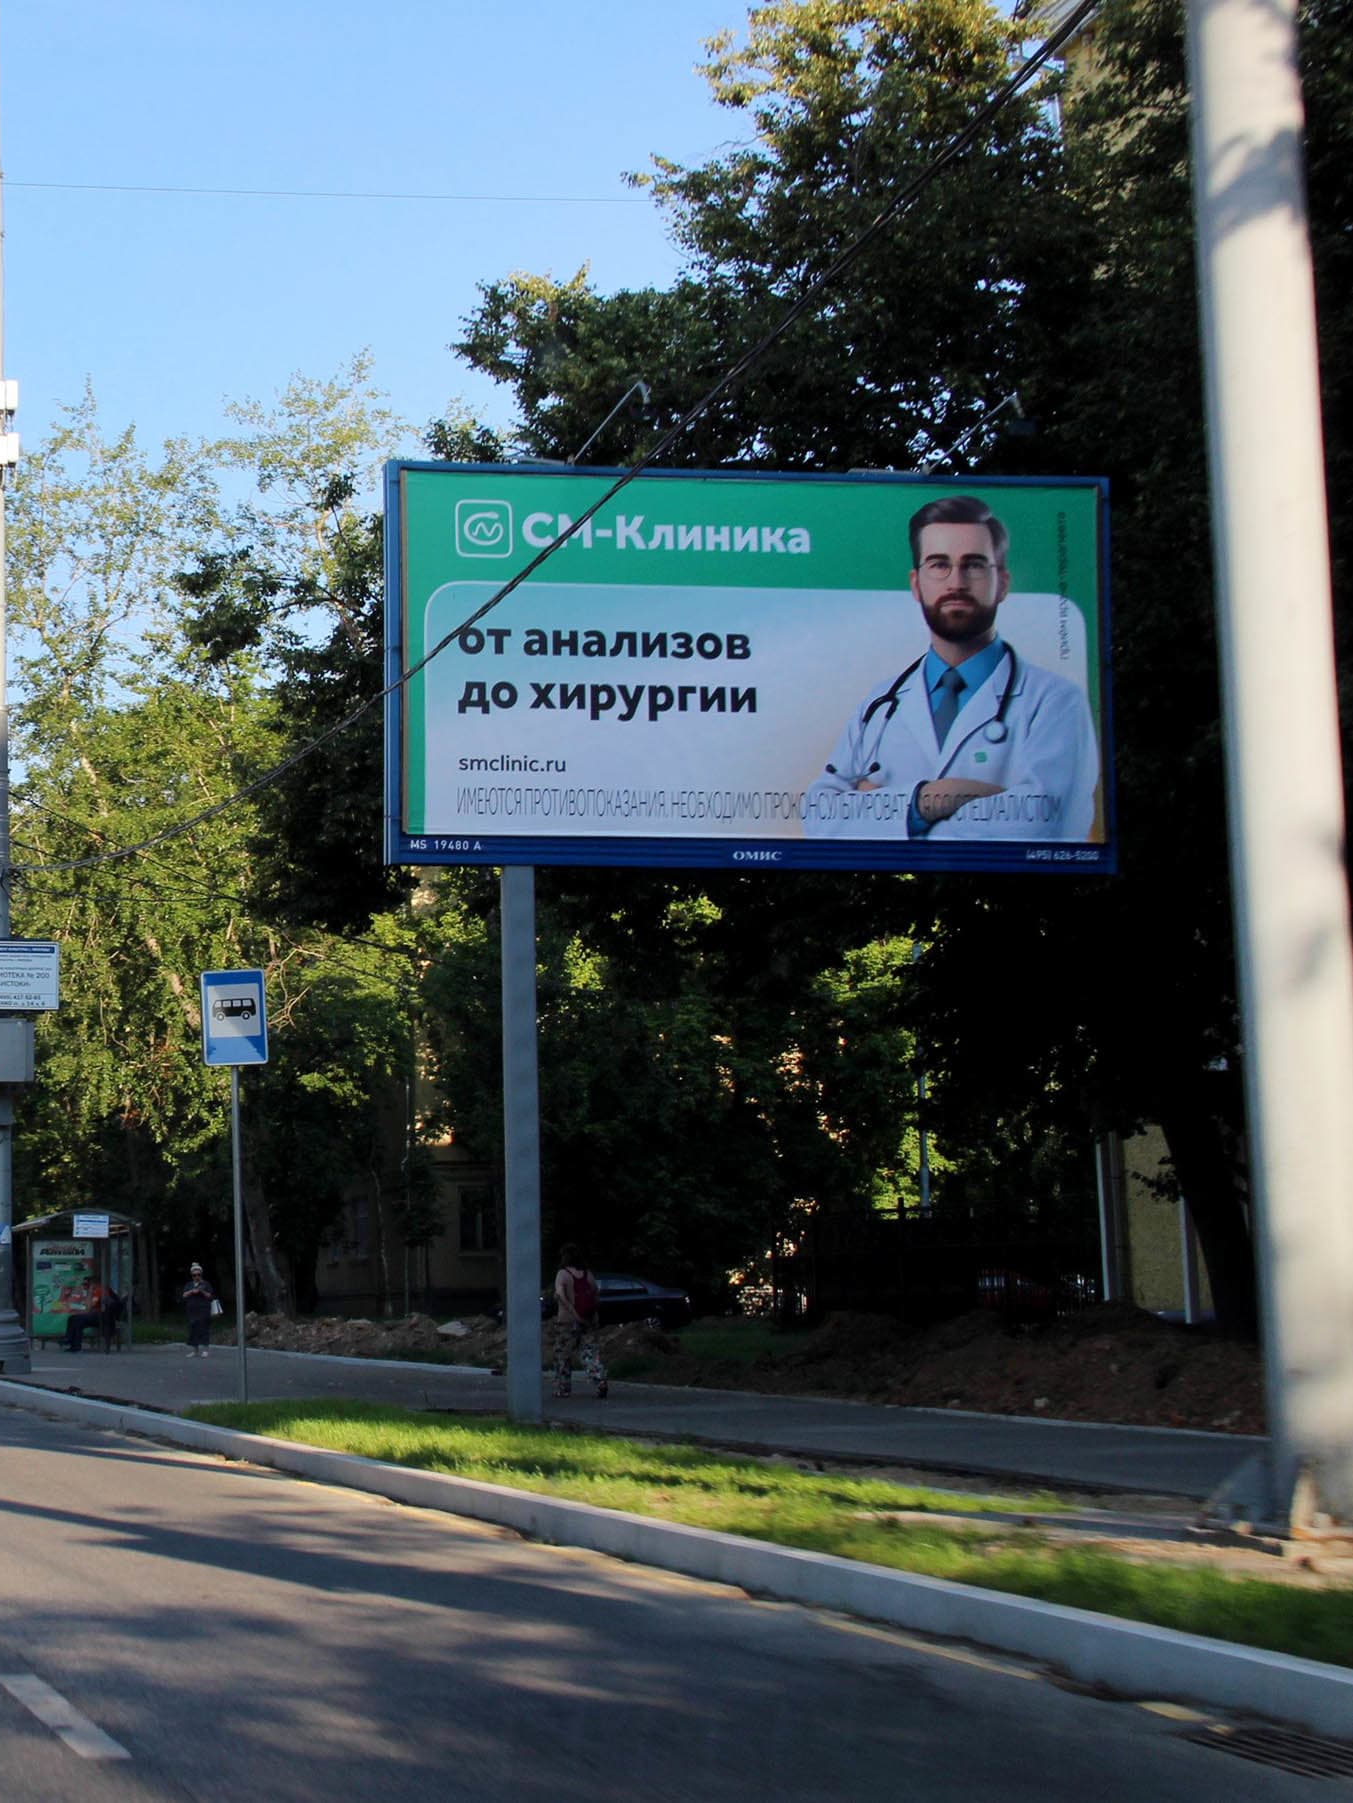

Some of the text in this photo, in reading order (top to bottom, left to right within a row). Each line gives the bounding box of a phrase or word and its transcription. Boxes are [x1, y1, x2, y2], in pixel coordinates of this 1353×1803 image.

[521, 511, 811, 554] СМ-Клиника
[457, 627, 752, 660] от анализов
[457, 681, 758, 722] до хирургии
[458, 754, 567, 773] smclinic.ru
[456, 786, 522, 817] ИМЕЮТСЯ
[671, 789, 761, 824] НЕОБХОДИМО
[410, 839, 427, 850] MS
[434, 839, 469, 851] 19480
[732, 850, 783, 862] ОМИС
